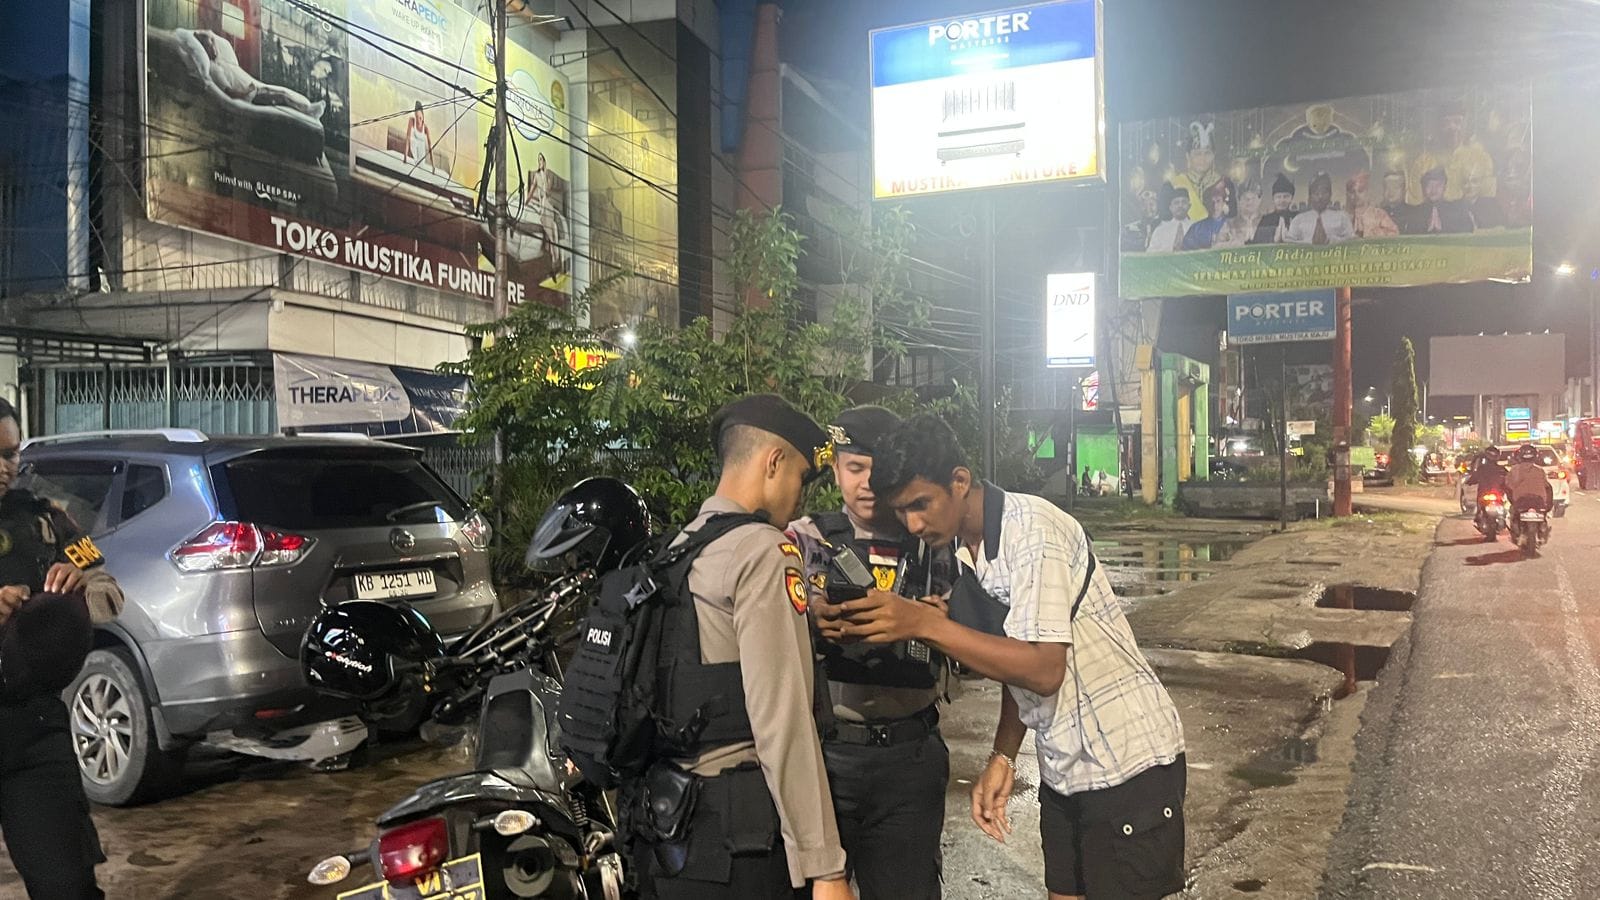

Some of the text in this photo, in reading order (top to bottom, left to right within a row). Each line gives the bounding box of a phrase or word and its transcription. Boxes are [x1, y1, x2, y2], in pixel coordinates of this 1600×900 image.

[928, 12, 1030, 48] PORTER
[237, 179, 253, 191] with
[270, 216, 525, 304] TOKO MUSTIKA FURNITRE
[1053, 293, 1090, 306] DND
[1235, 301, 1324, 321] PORTER
[358, 574, 374, 592] KB
[381, 571, 412, 589] 1251
[587, 628, 611, 646] POLISI
